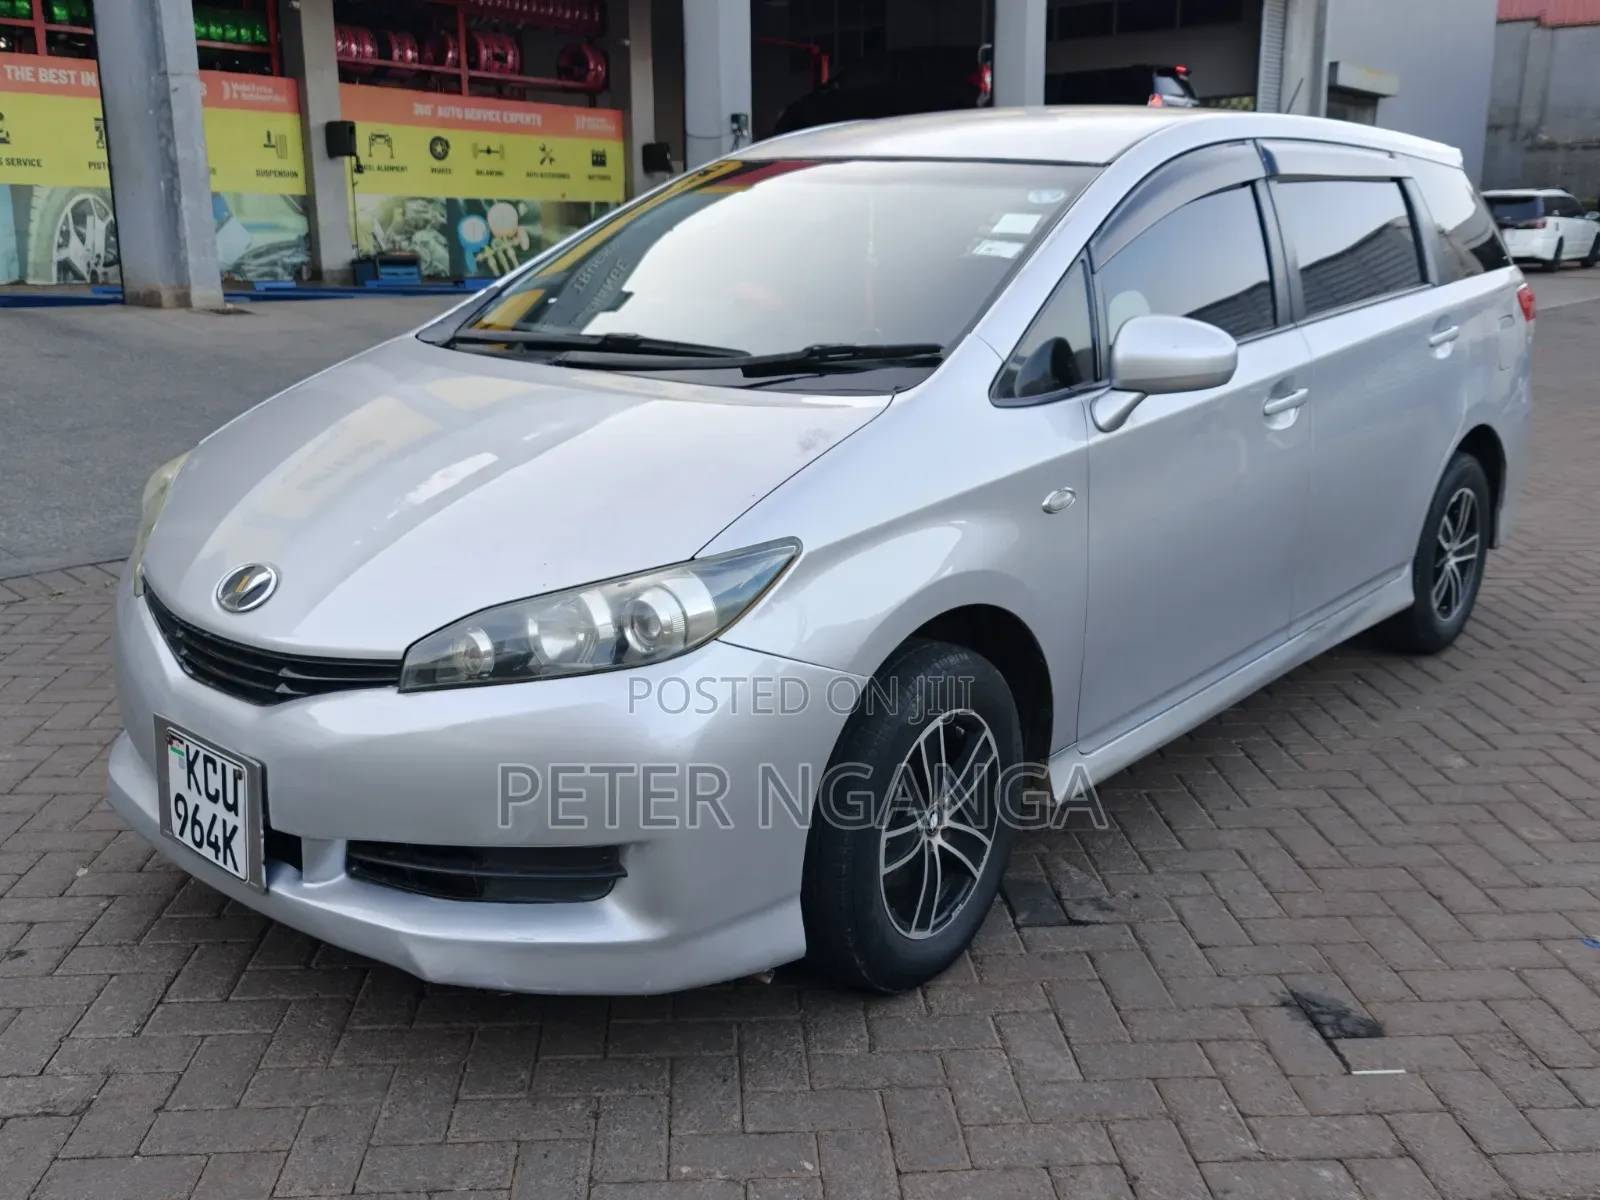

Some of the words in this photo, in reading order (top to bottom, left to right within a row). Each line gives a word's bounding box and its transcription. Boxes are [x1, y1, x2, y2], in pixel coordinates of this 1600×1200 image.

[3, 64, 36, 82] THE
[38, 67, 77, 85] BEST
[81, 71, 97, 87] IN
[437, 105, 463, 119] AUTO
[464, 107, 501, 123] SERVICE
[502, 110, 543, 127] EXPERTS
[5, 157, 43, 168] SERVICE
[88, 161, 107, 170] PIST
[255, 168, 299, 178] SUSPENSION
[185, 743, 239, 818] KCU
[174, 792, 240, 873] 964K
